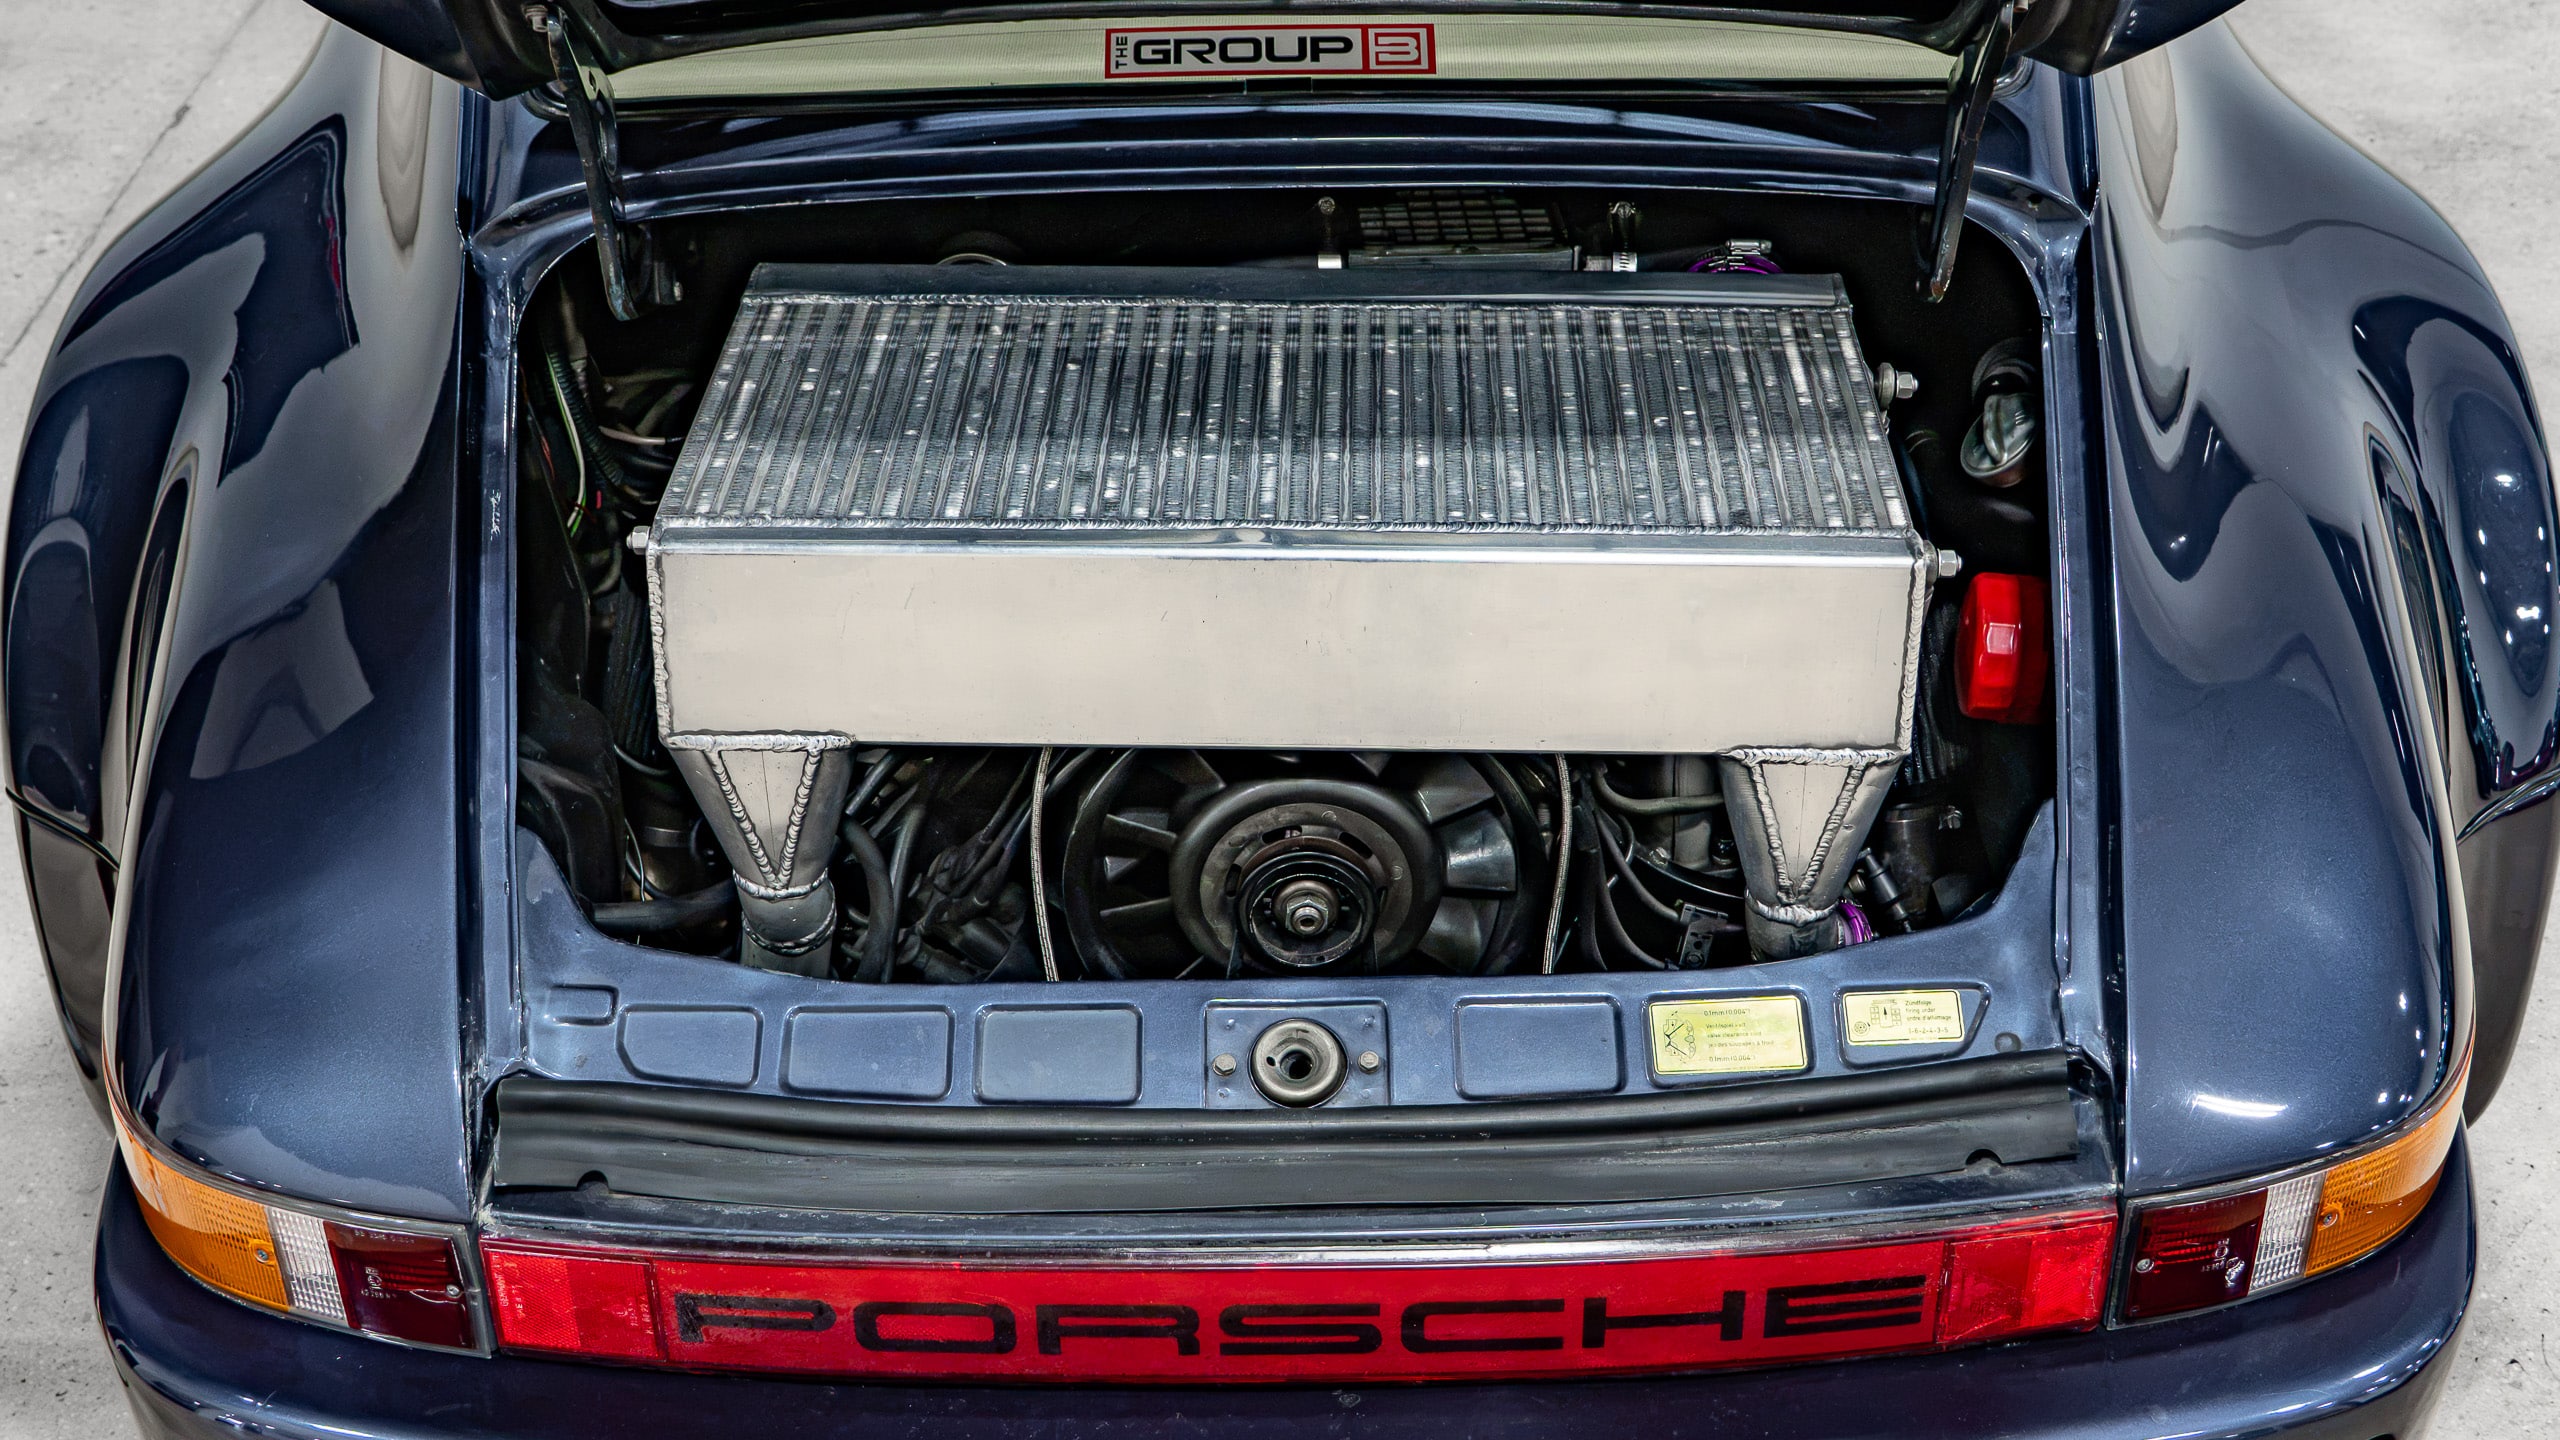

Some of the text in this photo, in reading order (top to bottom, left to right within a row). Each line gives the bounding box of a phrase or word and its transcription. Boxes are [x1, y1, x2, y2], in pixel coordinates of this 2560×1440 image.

[1116, 36, 1128, 69] THE
[1133, 36, 1354, 65] GROUP
[674, 1275, 1927, 1356] PORSCHE
